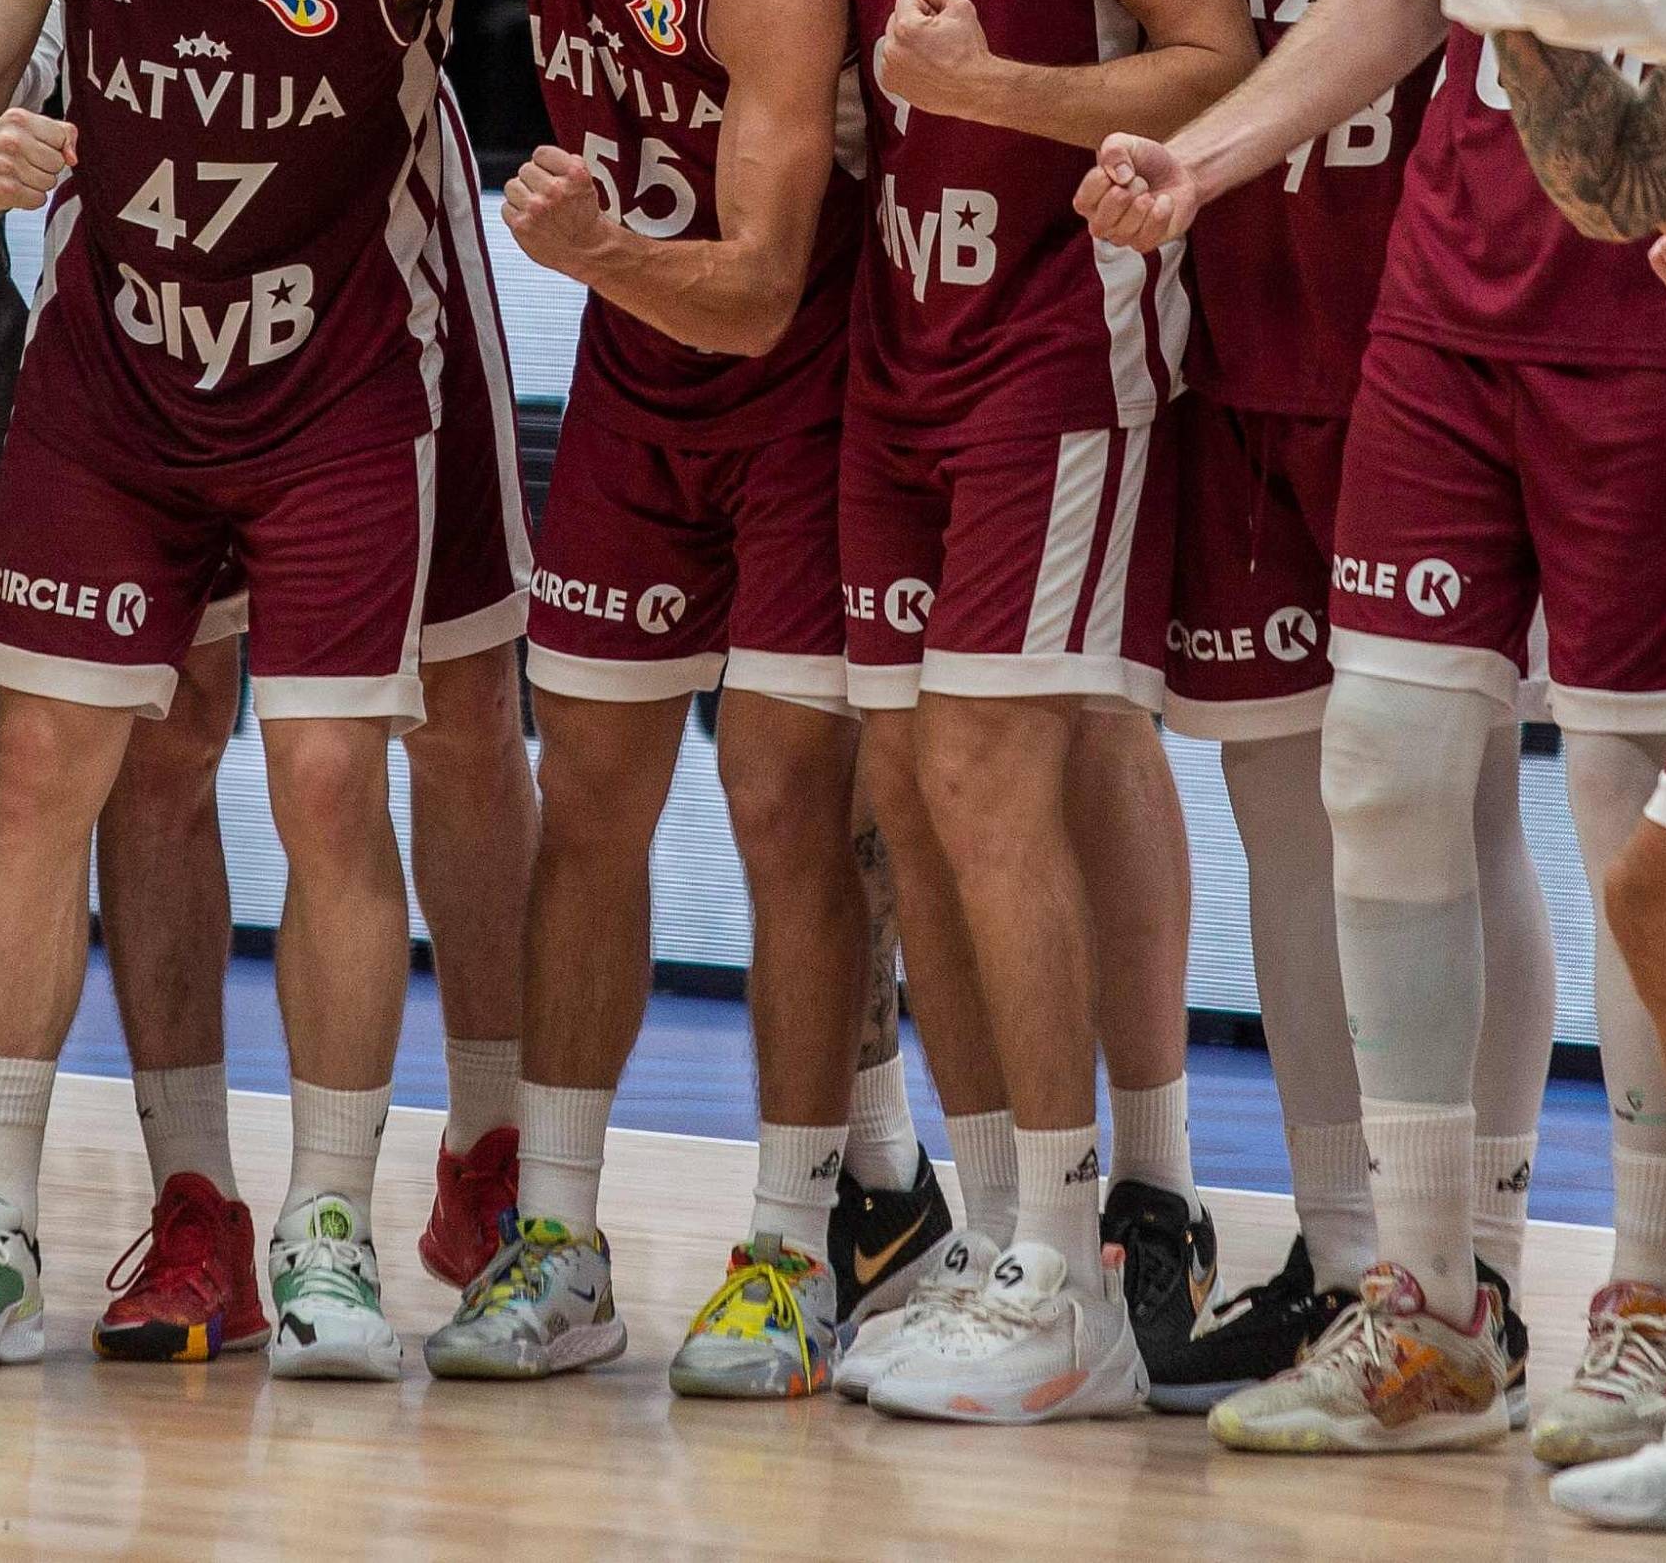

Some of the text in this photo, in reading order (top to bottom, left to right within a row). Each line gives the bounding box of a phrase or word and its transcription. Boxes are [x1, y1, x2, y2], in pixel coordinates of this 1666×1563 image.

[87, 29, 347, 130] LATVIJA
[116, 158, 279, 254] 47
[113, 590, 144, 636] K
[530, 565, 684, 632] CIRCLE K
[1332, 553, 1456, 615] RCLE K
[1272, 612, 1313, 655] K
